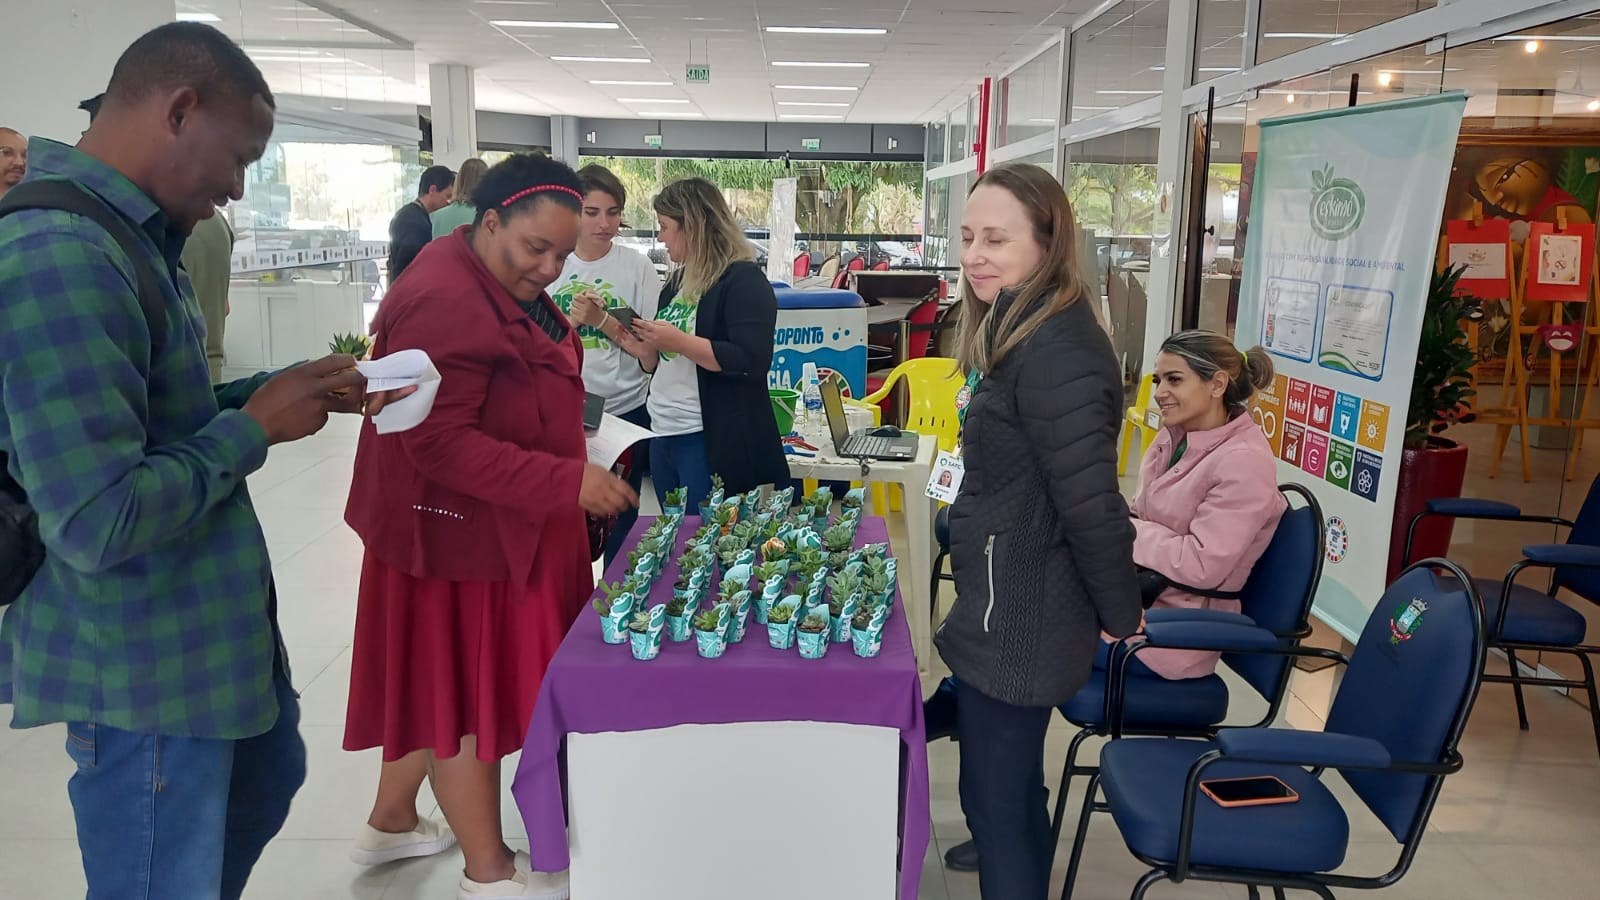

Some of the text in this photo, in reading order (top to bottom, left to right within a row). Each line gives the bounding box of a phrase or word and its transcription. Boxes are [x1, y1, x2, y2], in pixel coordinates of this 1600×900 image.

[687, 69, 709, 81] SAIDA
[1345, 257, 1366, 268] SOCIAL
[774, 327, 823, 345] OPONTO
